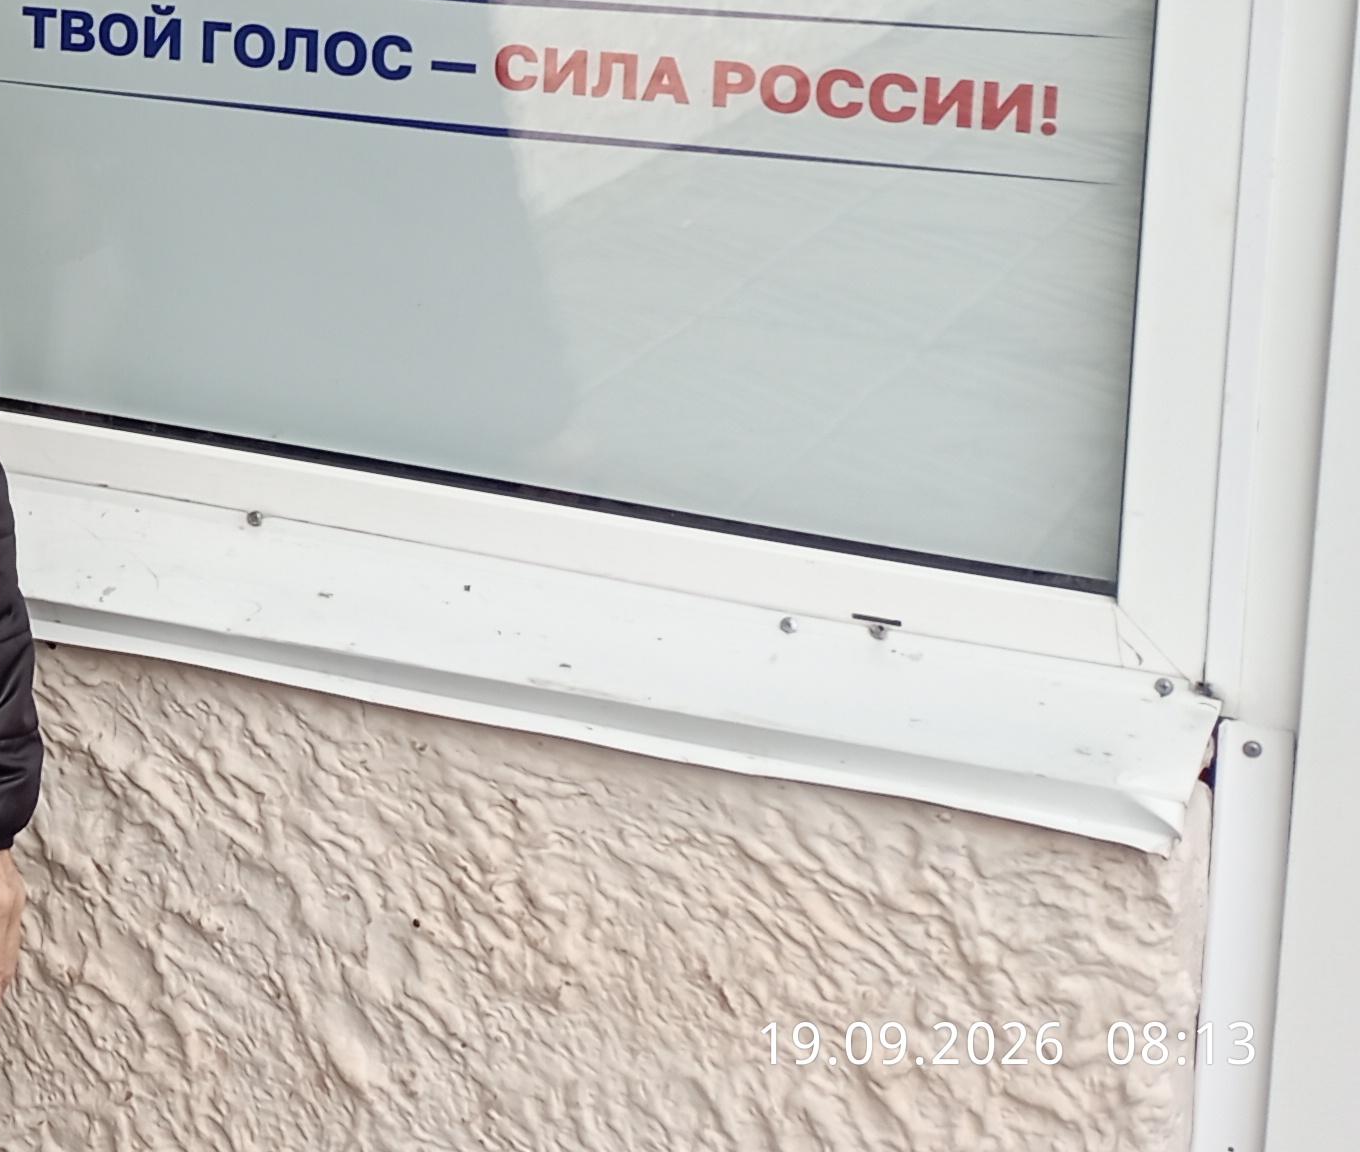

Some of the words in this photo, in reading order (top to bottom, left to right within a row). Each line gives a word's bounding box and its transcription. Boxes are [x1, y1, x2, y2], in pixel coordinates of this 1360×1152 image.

[23, 4, 183, 62] ТВОЙ
[201, 20, 414, 83] ГОЛОС
[494, 43, 689, 107] СИЛА
[713, 64, 1060, 139] РОССИИ!
